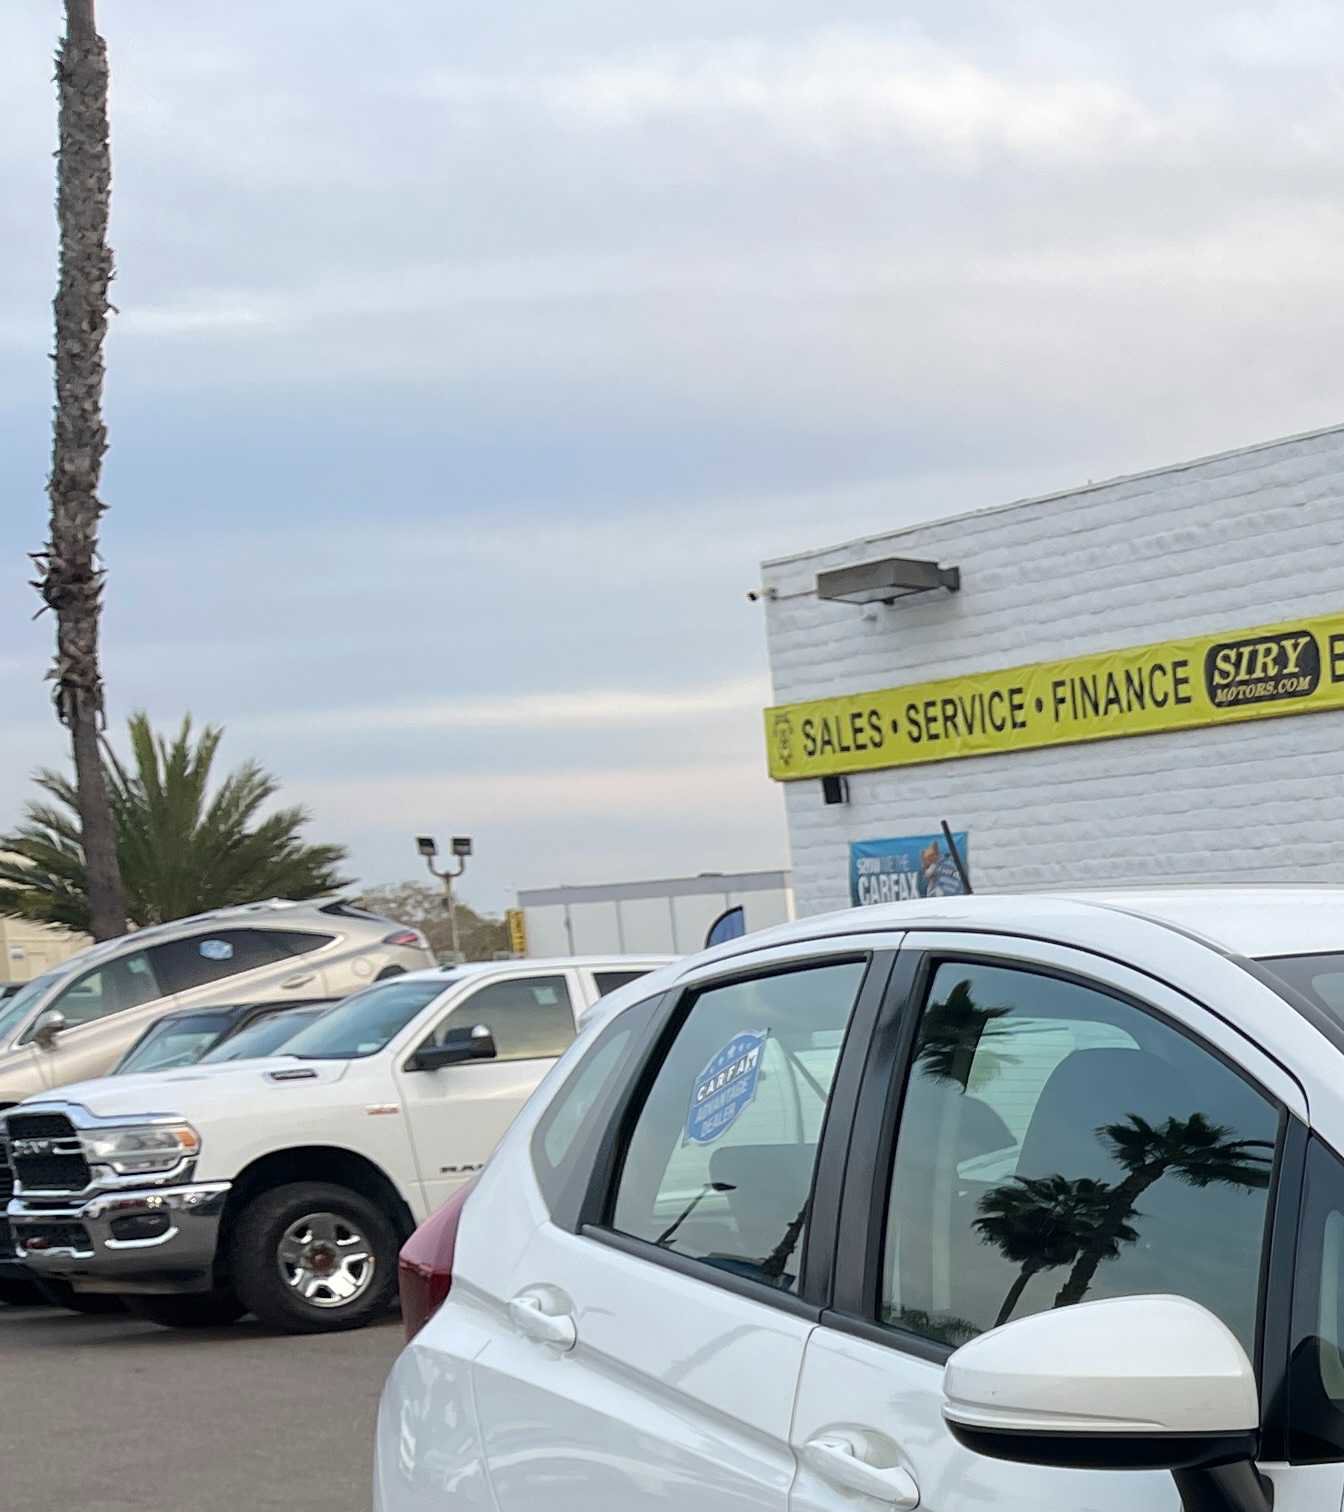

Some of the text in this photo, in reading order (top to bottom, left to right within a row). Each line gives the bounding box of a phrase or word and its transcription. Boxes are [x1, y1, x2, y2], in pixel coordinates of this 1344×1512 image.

[1211, 636, 1309, 685] SIRY
[803, 660, 1192, 756] SALES SERVICE FINANCE
[1214, 674, 1312, 704] MOTORS.COM
[858, 871, 919, 905] CARFAX
[697, 1047, 759, 1101] CARFAX
